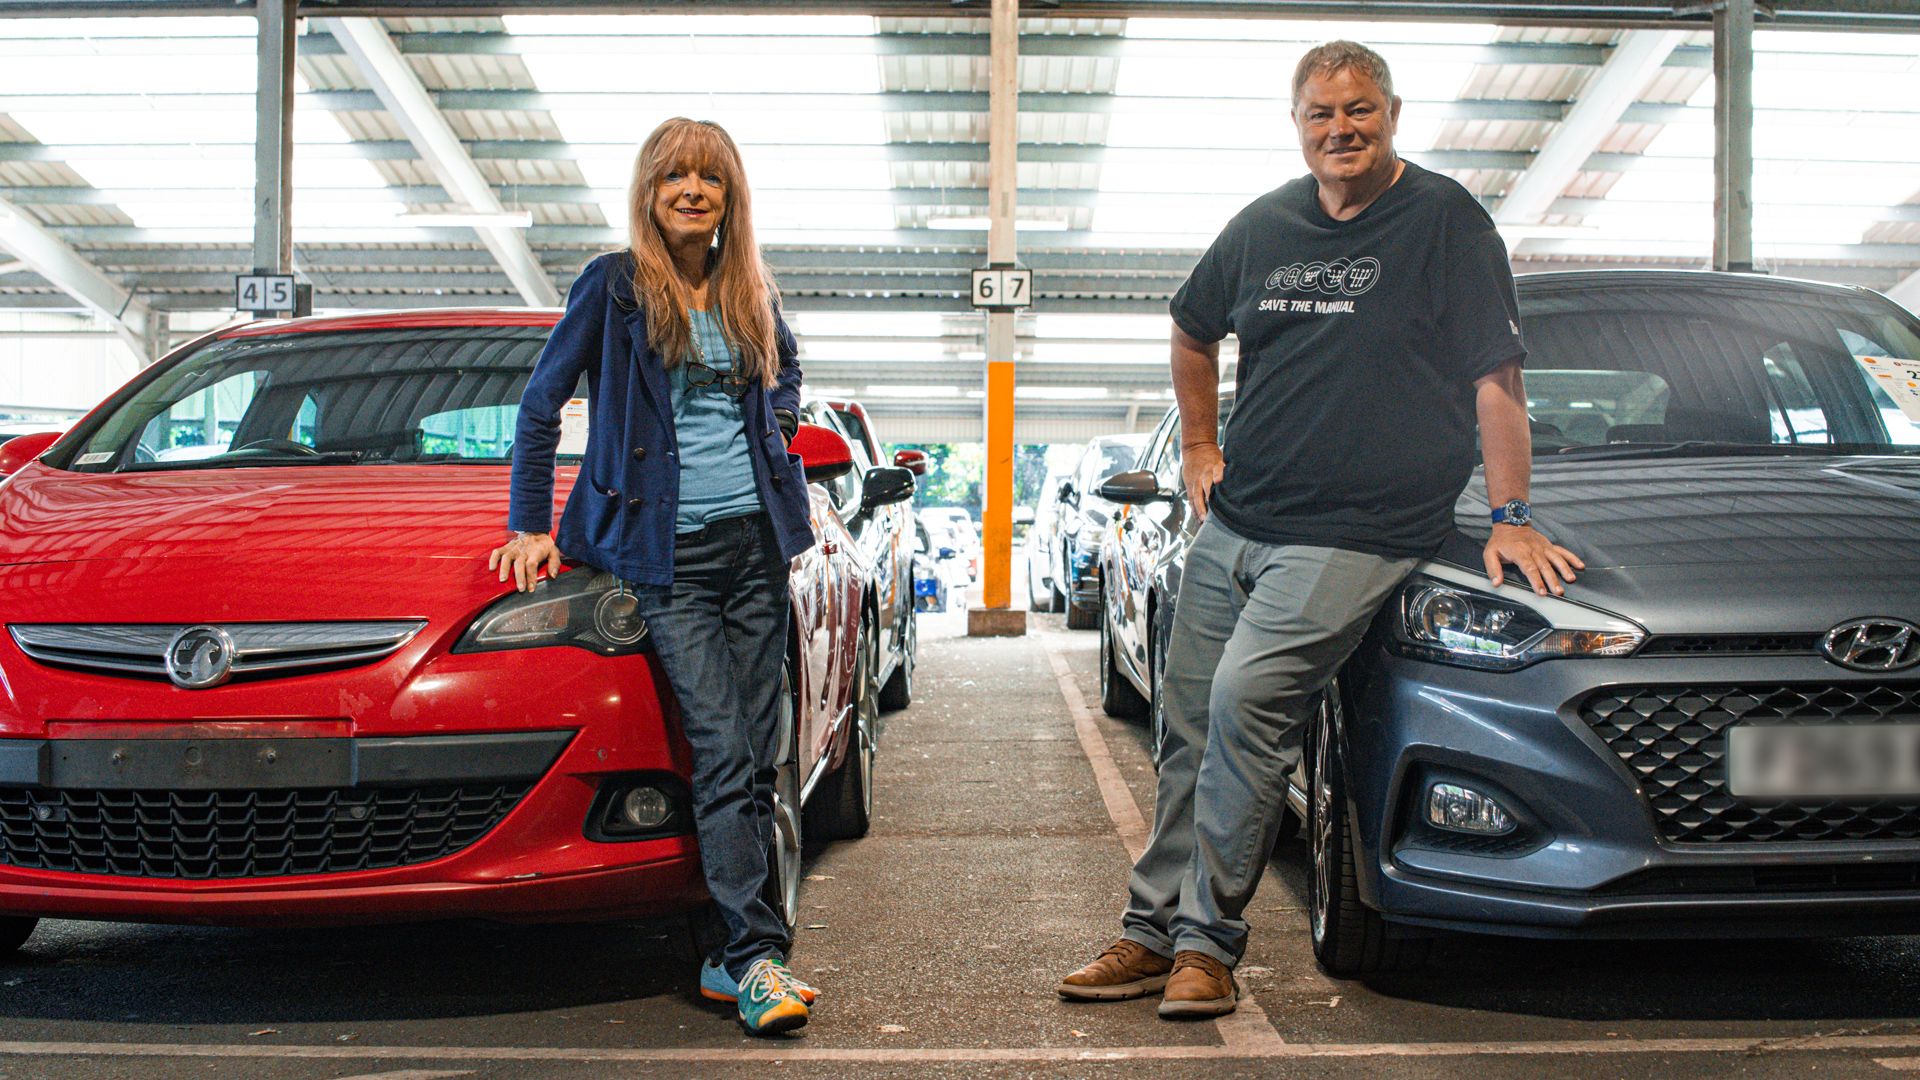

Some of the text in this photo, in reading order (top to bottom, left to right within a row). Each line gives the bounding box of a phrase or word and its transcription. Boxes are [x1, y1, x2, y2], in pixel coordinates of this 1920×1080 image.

[243, 282, 287, 303] 4 5
[979, 277, 1024, 299] 6 7
[1258, 299, 1355, 314] SAVE THE MANUAL
